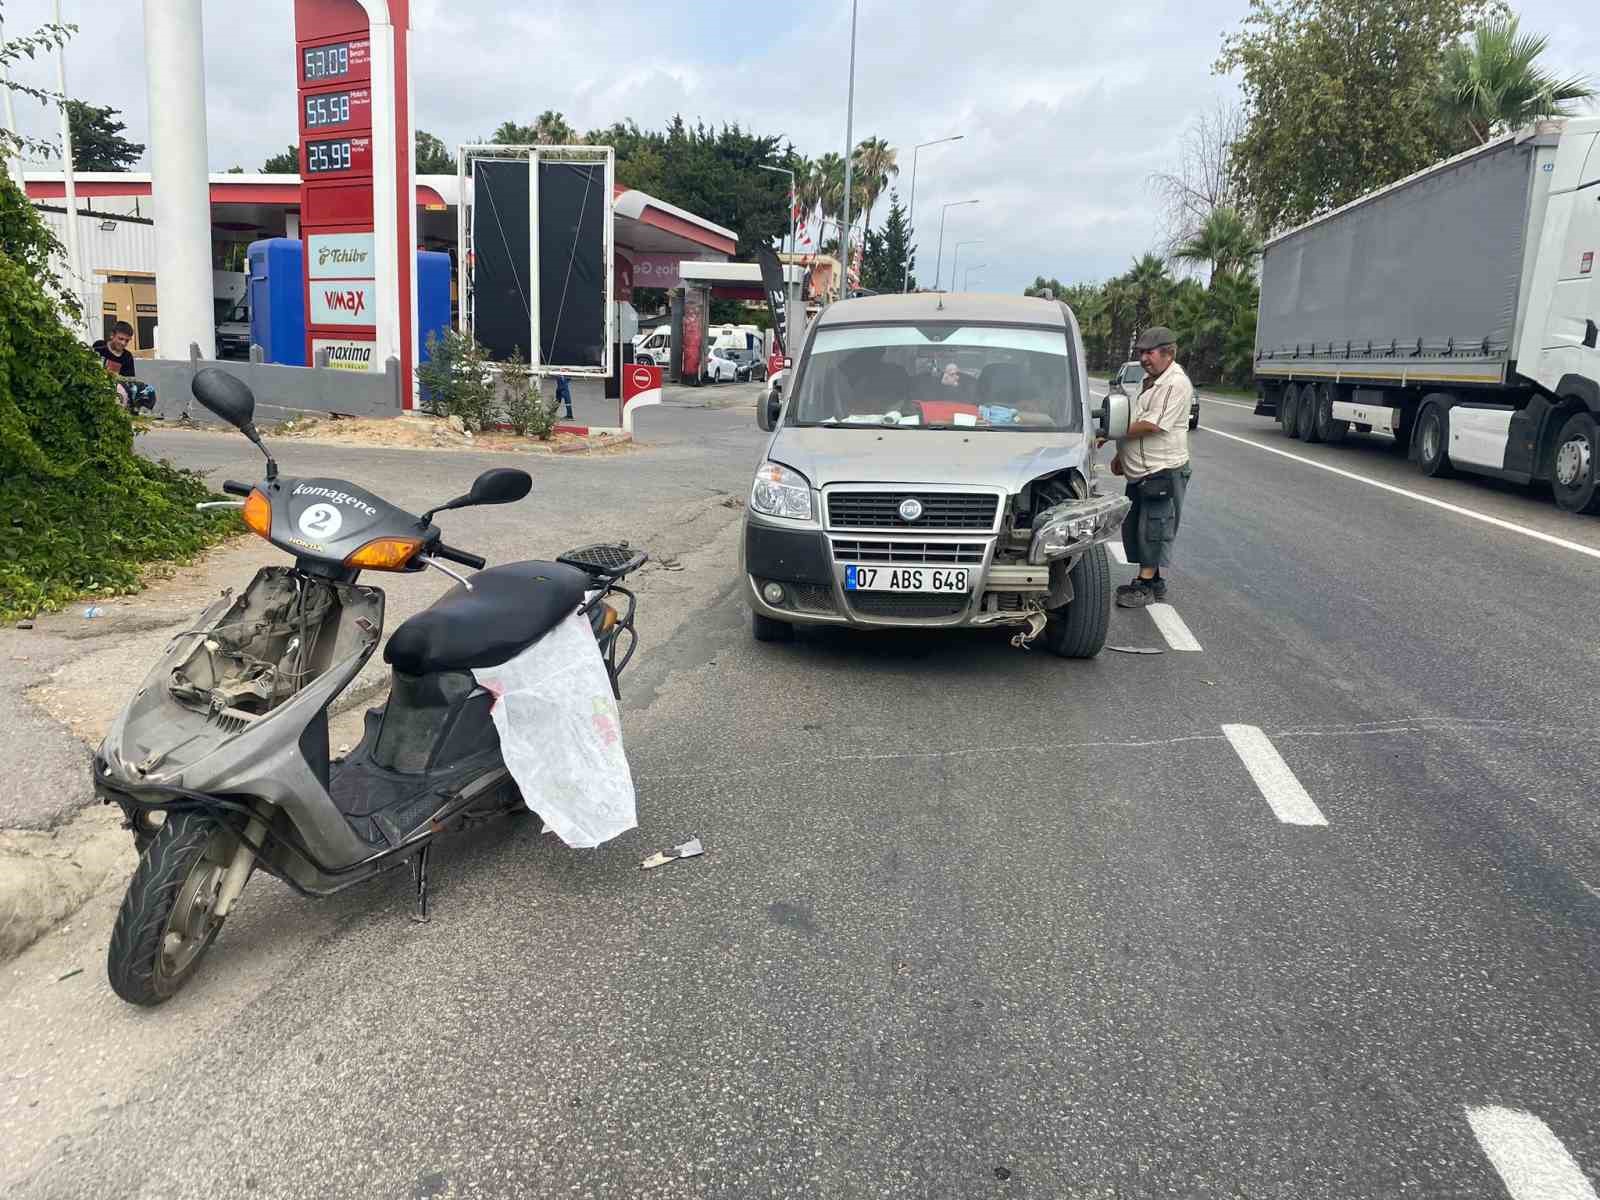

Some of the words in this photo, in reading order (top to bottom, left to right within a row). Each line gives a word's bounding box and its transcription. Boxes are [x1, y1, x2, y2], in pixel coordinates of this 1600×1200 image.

[307, 96, 349, 124] 55.58
[309, 143, 351, 170] 25.99
[331, 247, 368, 263] Tchibo
[292, 483, 377, 517] komagene
[307, 510, 332, 532] 2
[857, 568, 878, 588] 07
[889, 570, 923, 589] ABS
[932, 571, 966, 591] 648
